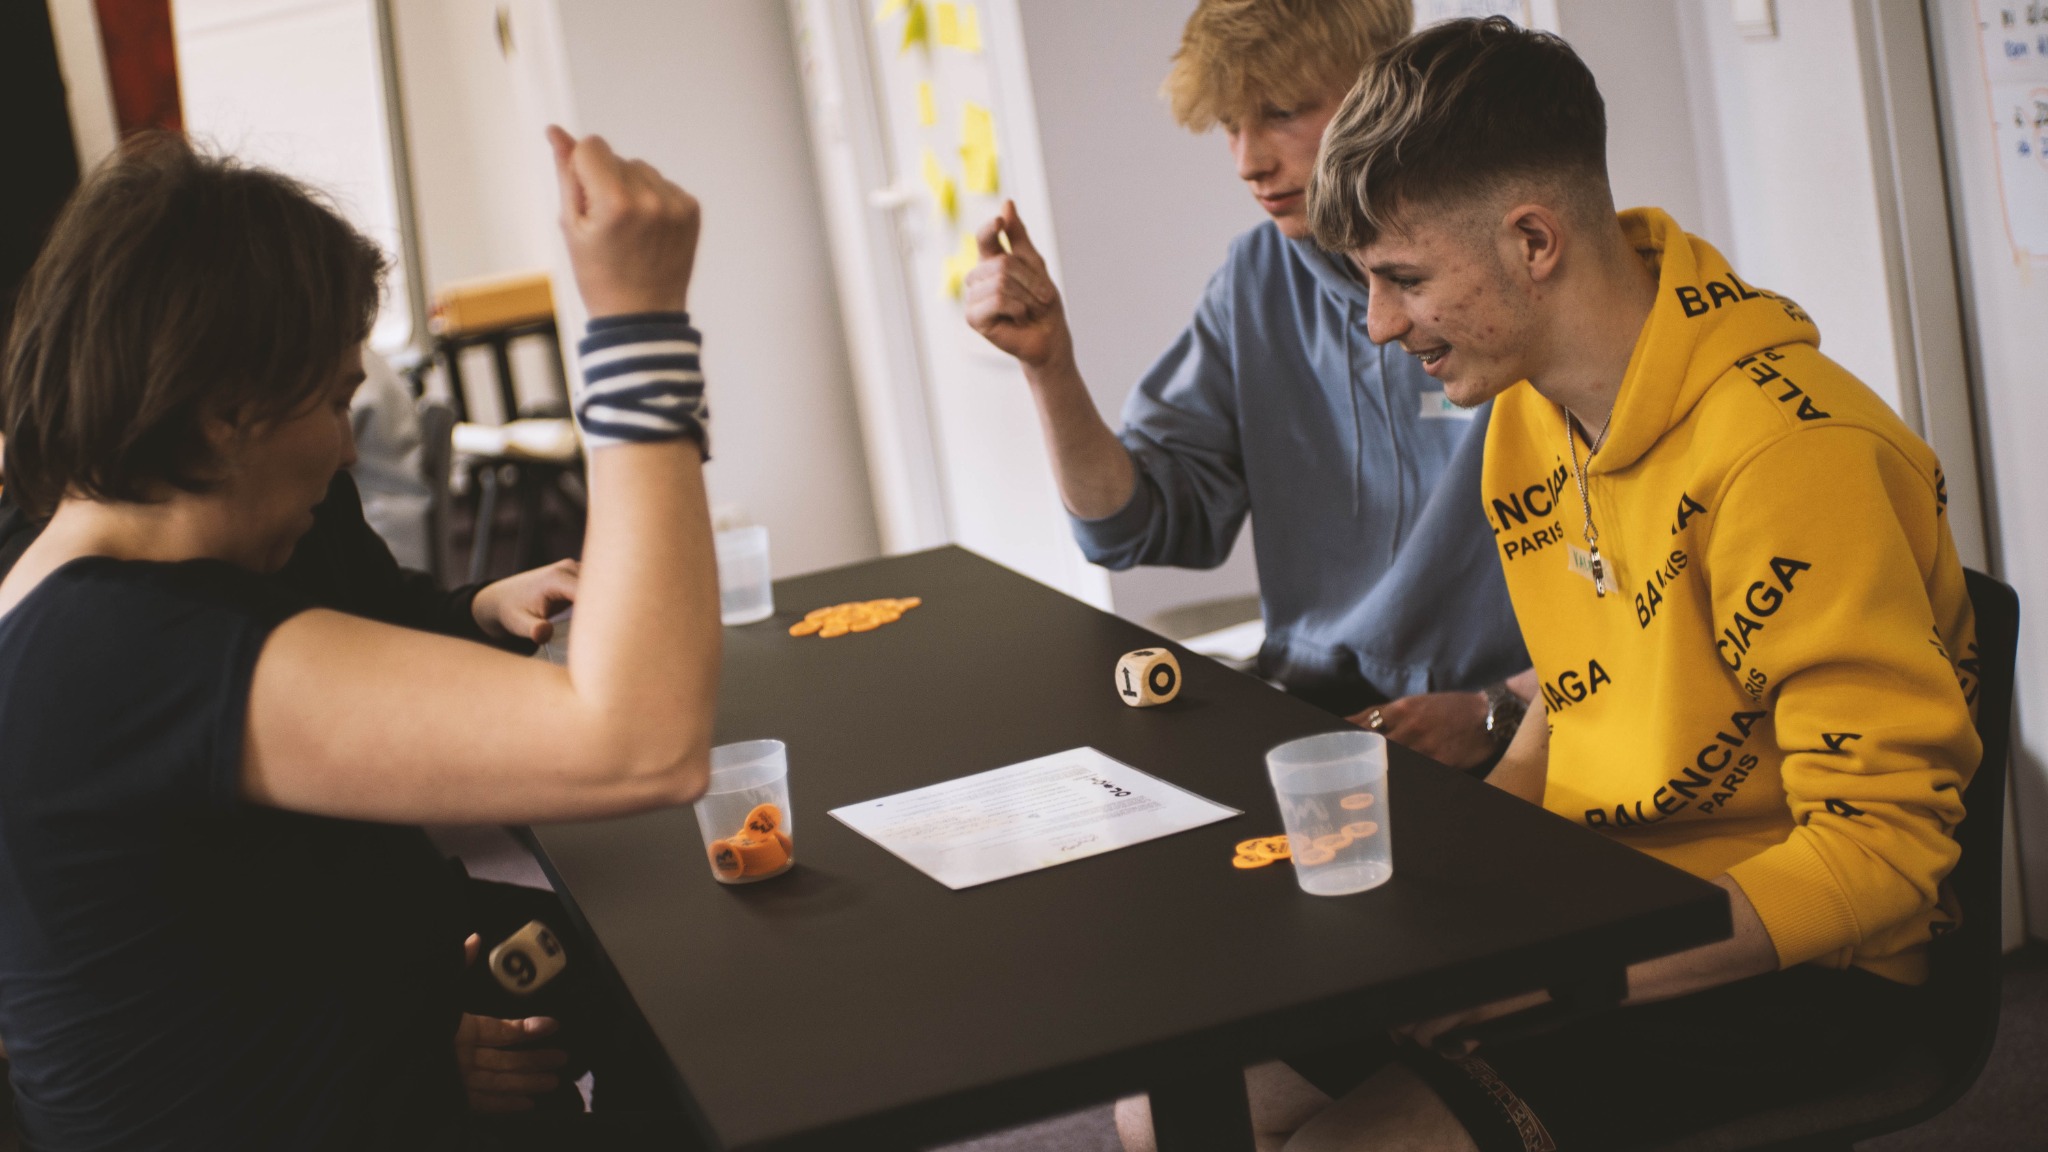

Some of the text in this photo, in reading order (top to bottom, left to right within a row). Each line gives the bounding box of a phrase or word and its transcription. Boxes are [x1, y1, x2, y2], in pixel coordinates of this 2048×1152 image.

[1503, 520, 1564, 561] PARIS
[1717, 556, 1813, 672] CIAGA
[1541, 659, 1612, 717] IAGA
[1698, 753, 1759, 815] PARIS
